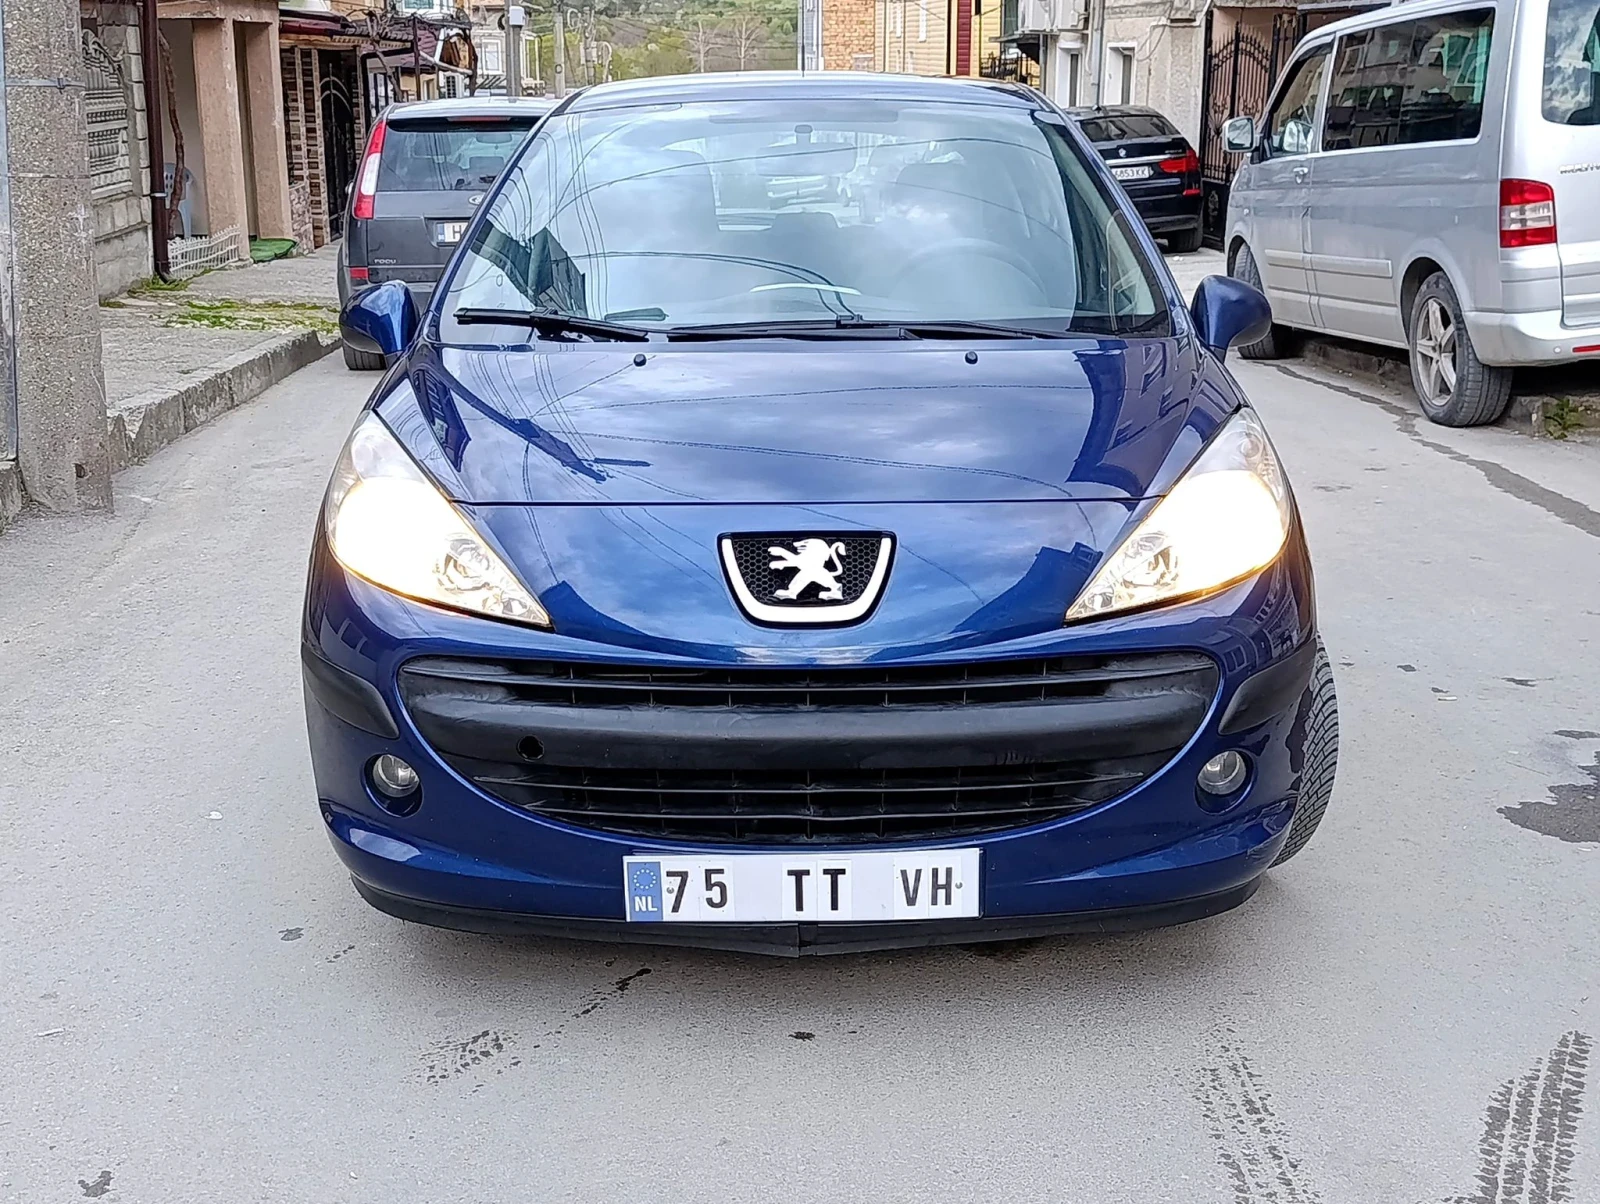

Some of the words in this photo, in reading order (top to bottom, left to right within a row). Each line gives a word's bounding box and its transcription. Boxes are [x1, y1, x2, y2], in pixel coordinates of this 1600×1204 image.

[634, 895, 658, 912] NL
[665, 868, 728, 913] 75
[787, 868, 847, 912] TT
[899, 866, 952, 907] VH
